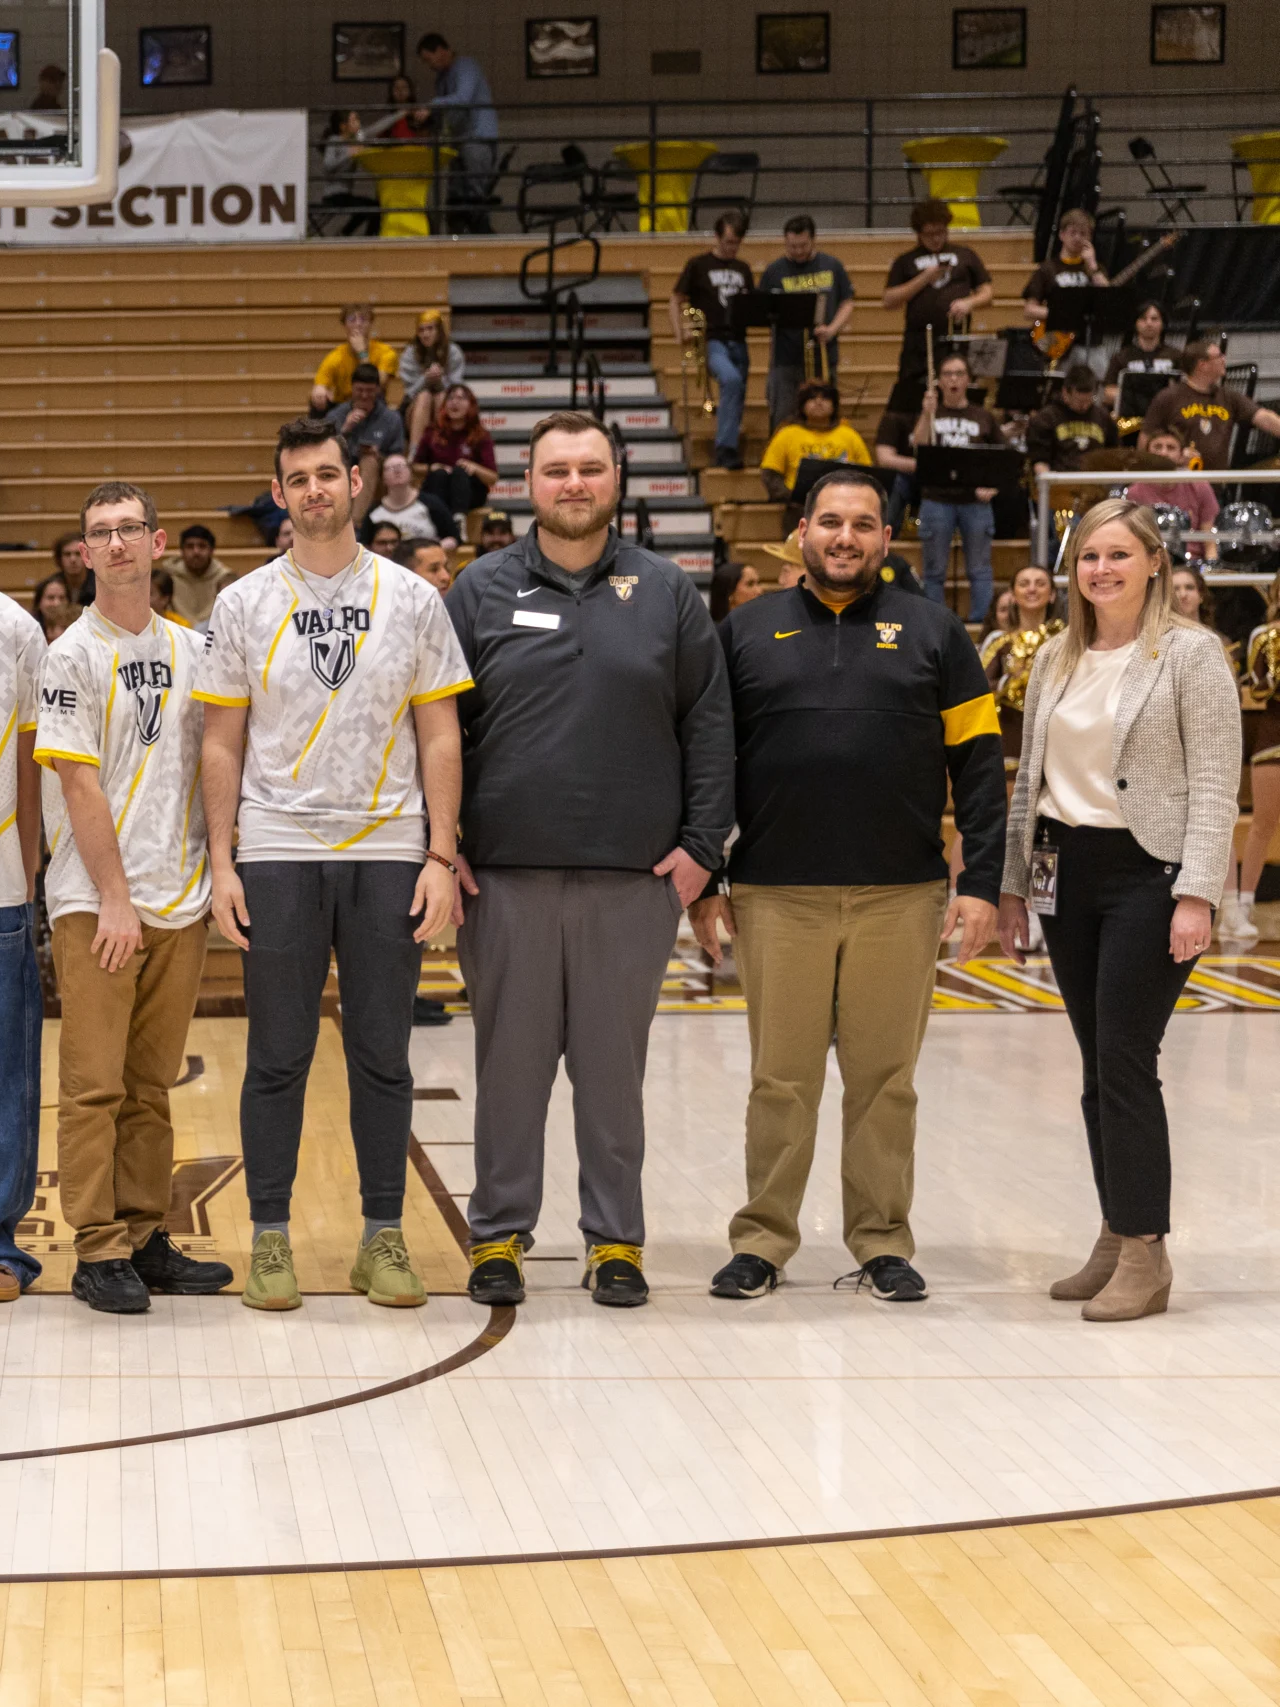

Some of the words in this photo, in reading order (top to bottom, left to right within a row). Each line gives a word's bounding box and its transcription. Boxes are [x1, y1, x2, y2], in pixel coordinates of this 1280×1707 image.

[51, 184, 296, 228] SECTION
[649, 483, 686, 496] meijer
[608, 576, 639, 587] VALPO
[292, 606, 370, 636] VALPO
[875, 622, 903, 632] VALPO
[117, 660, 173, 691] VALPO
[60, 709, 76, 717] ME
